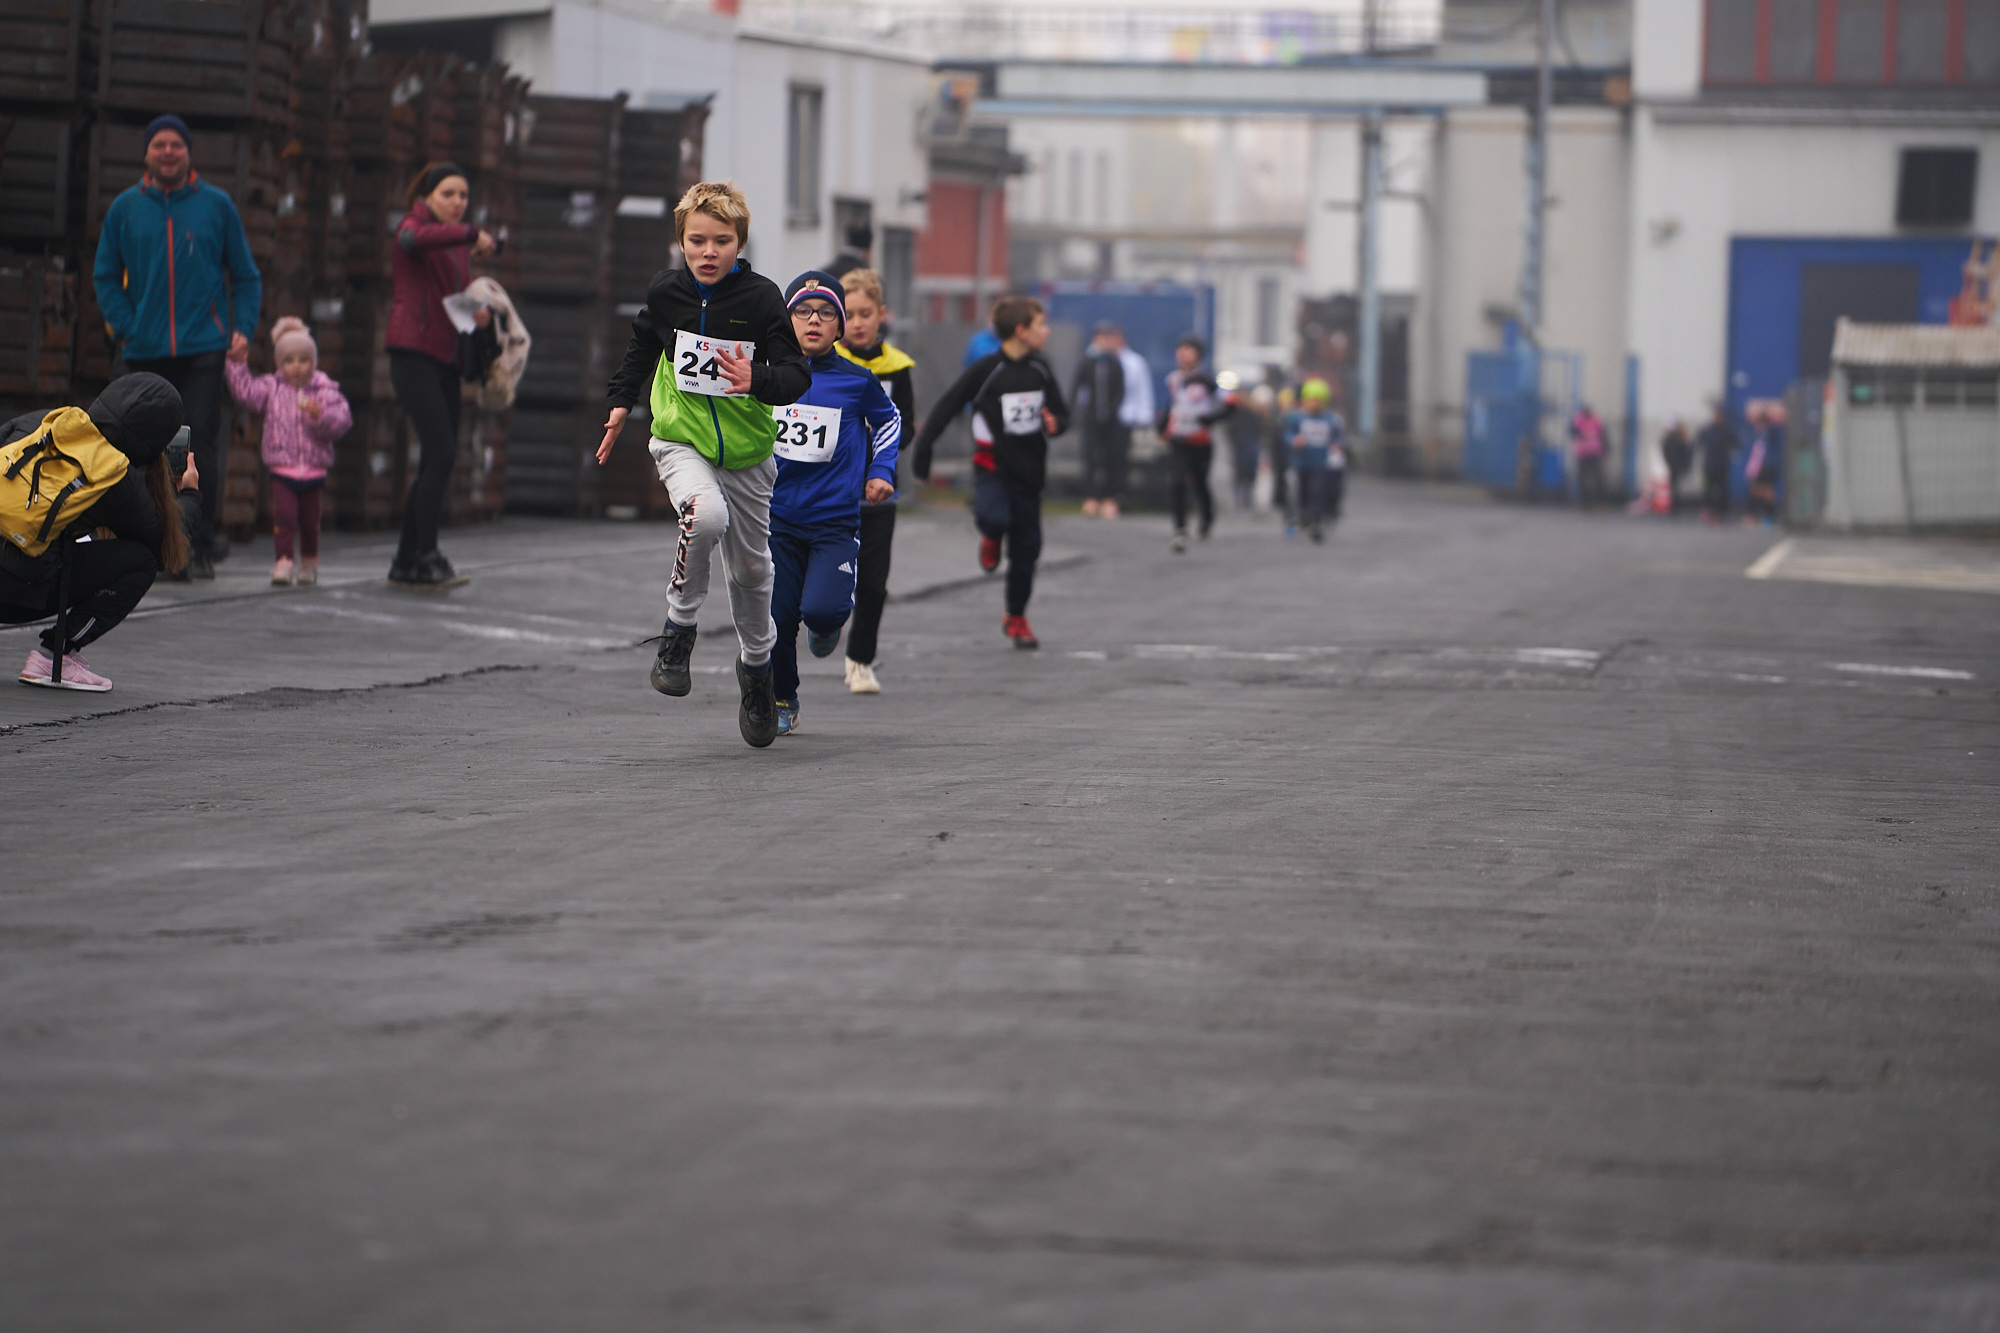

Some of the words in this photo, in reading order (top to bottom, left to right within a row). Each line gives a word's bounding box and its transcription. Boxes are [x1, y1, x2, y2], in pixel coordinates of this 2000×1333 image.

[695, 340, 710, 351] K5
[678, 351, 721, 381] 24
[785, 408, 799, 418] K5
[776, 419, 827, 449] 231
